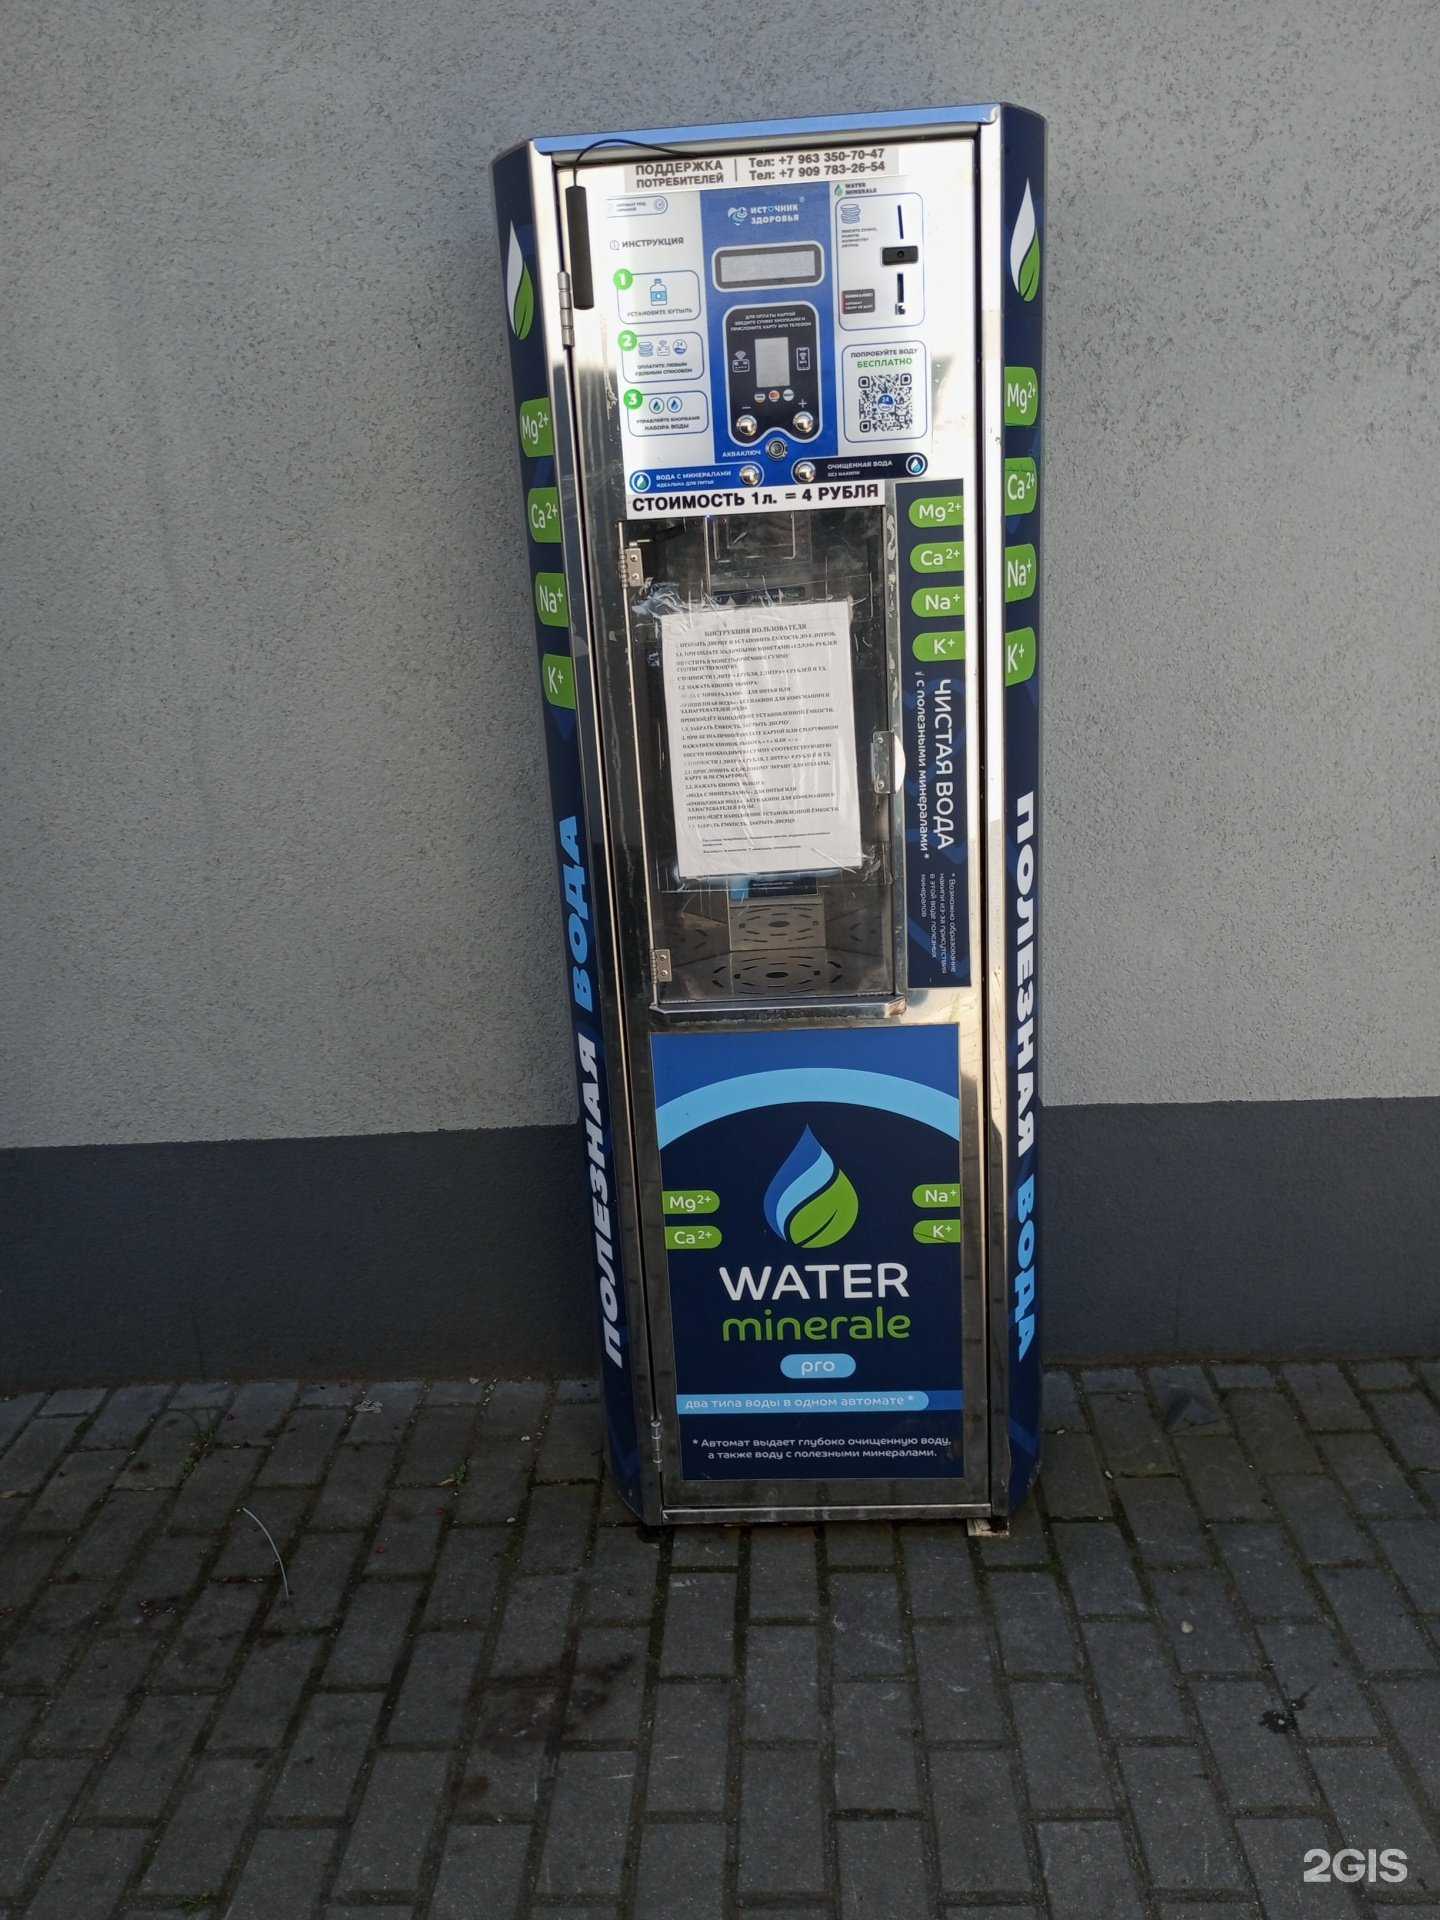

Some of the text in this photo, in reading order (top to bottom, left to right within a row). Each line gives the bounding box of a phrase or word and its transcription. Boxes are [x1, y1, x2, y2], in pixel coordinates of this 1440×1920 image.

[748, 148, 884, 168] Тел: +7 963 350-70-47
[635, 160, 723, 177] ПОДДЕРЖКА
[750, 161, 885, 181] Тел: +7 909 783-26-54
[636, 172, 724, 188] ПОТРЕБИТЕЛЕЙ
[751, 214, 799, 225] ЗДОРОВЬЯ
[622, 237, 684, 249] ИНСТРУКЦИЯ
[620, 274, 626, 285] 1
[627, 309, 666, 317] УСТАНОВИТЕ
[623, 335, 632, 346] 2
[851, 349, 897, 358] ПОПРОБУЙТЕ
[857, 358, 912, 368] БЕСПЛАТНО
[629, 393, 637, 405] 3
[827, 461, 872, 470] ОЧИЩЕННАЯ
[656, 473, 675, 481] ВОДА
[683, 471, 731, 479] МИНЕРАЛАМИ
[633, 493, 745, 511] СТОИМОСТЬ
[802, 488, 812, 501] 4
[819, 484, 878, 500] РУБЛЯ
[917, 691, 928, 767] полезными
[933, 679, 954, 849] ЧИСТАЯ ВОДА
[918, 771, 929, 851] минералами
[948, 879, 957, 973] Возможно образование
[1016, 792, 1036, 1362] ПОЛЕЗНАЯ ВОДА
[559, 816, 624, 1368] ПОЛЕЗНАЯ ВОДА
[719, 1263, 910, 1301] WATER
[722, 1306, 911, 1342] minerale
[801, 1358, 835, 1376] pro
[685, 1396, 904, 1409] два типа воды в одном автомате
[701, 1438, 750, 1448] Автомат
[753, 1438, 795, 1448] выдает
[798, 1436, 845, 1448] глубоко
[848, 1437, 918, 1448] очищенную
[716, 1450, 752, 1460] также
[755, 1450, 783, 1461] воду
[795, 1449, 859, 1458] полезными
[862, 1449, 937, 1460] минералами.
